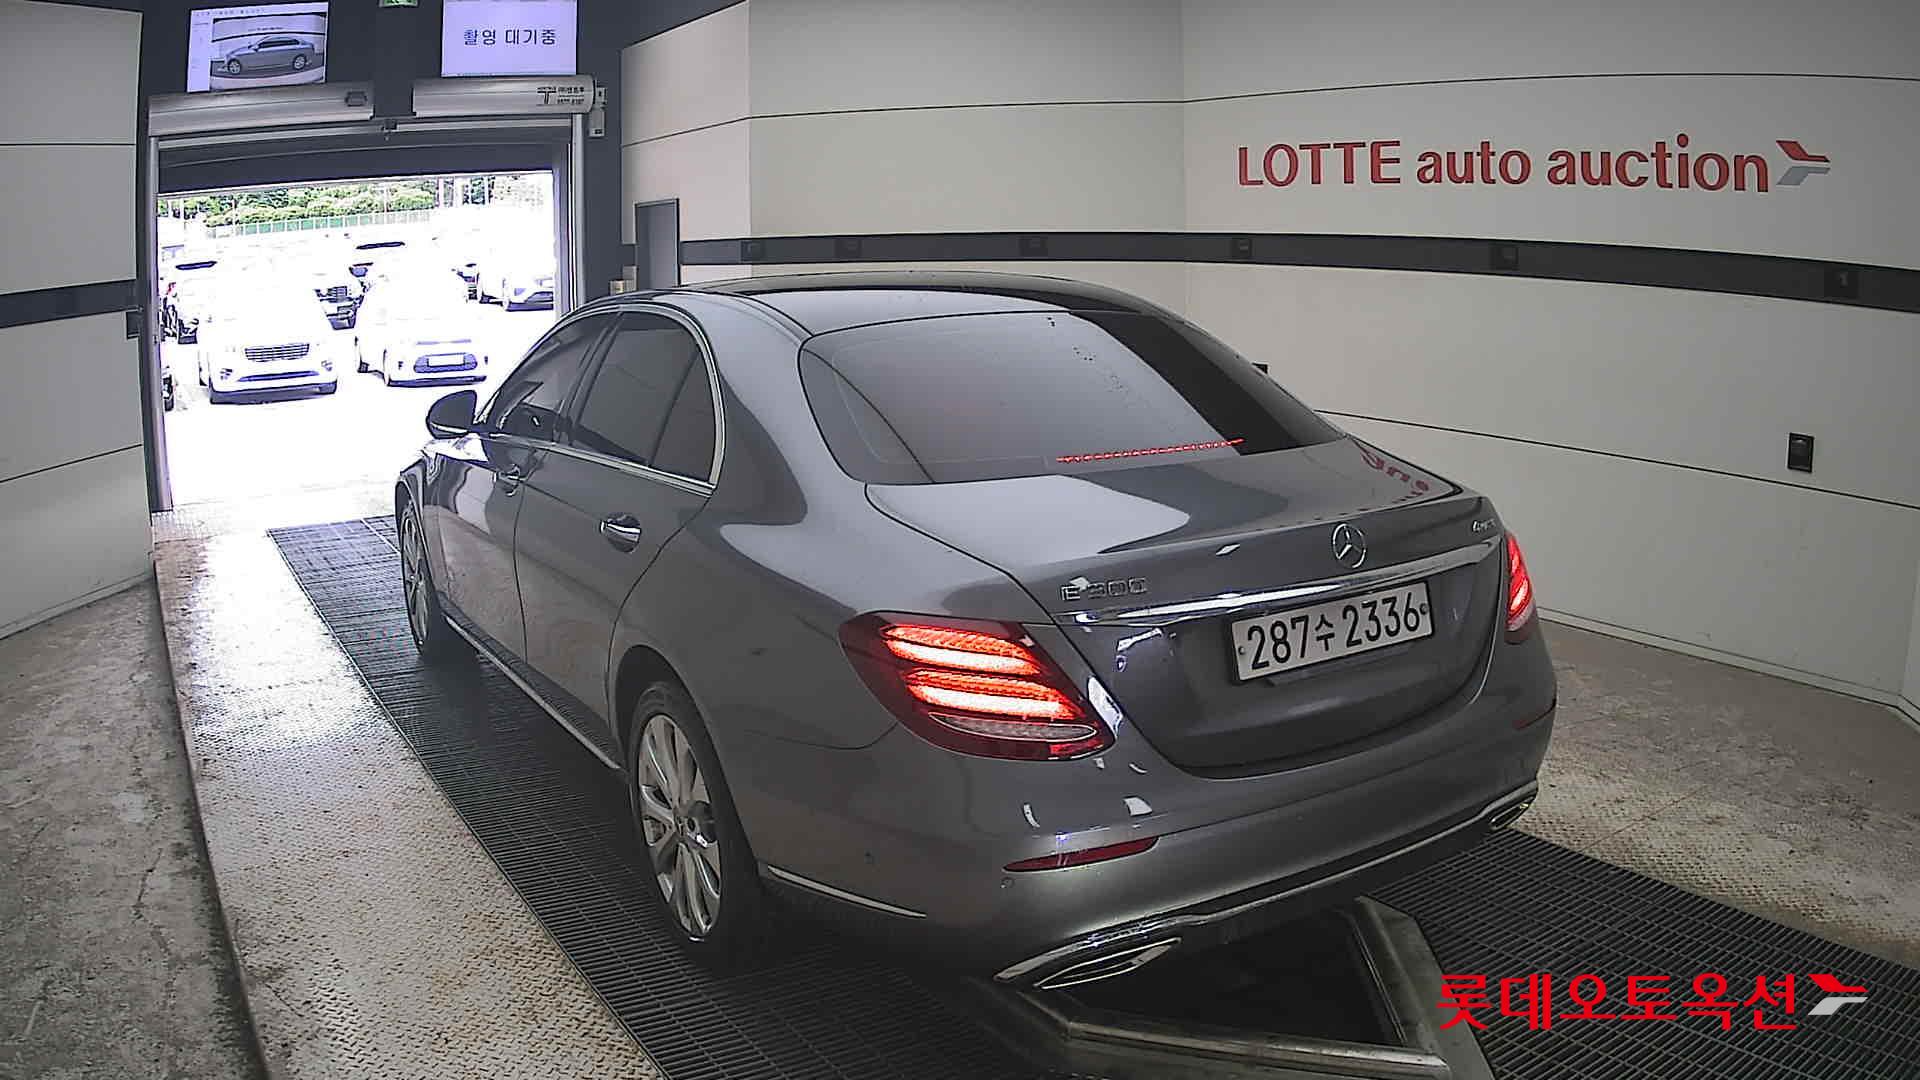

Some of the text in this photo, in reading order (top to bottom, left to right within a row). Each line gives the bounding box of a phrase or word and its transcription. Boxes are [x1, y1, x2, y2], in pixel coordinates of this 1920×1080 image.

[505, 29, 556, 46] 대기중
[1238, 132, 1769, 193] LOTTE auto auction
